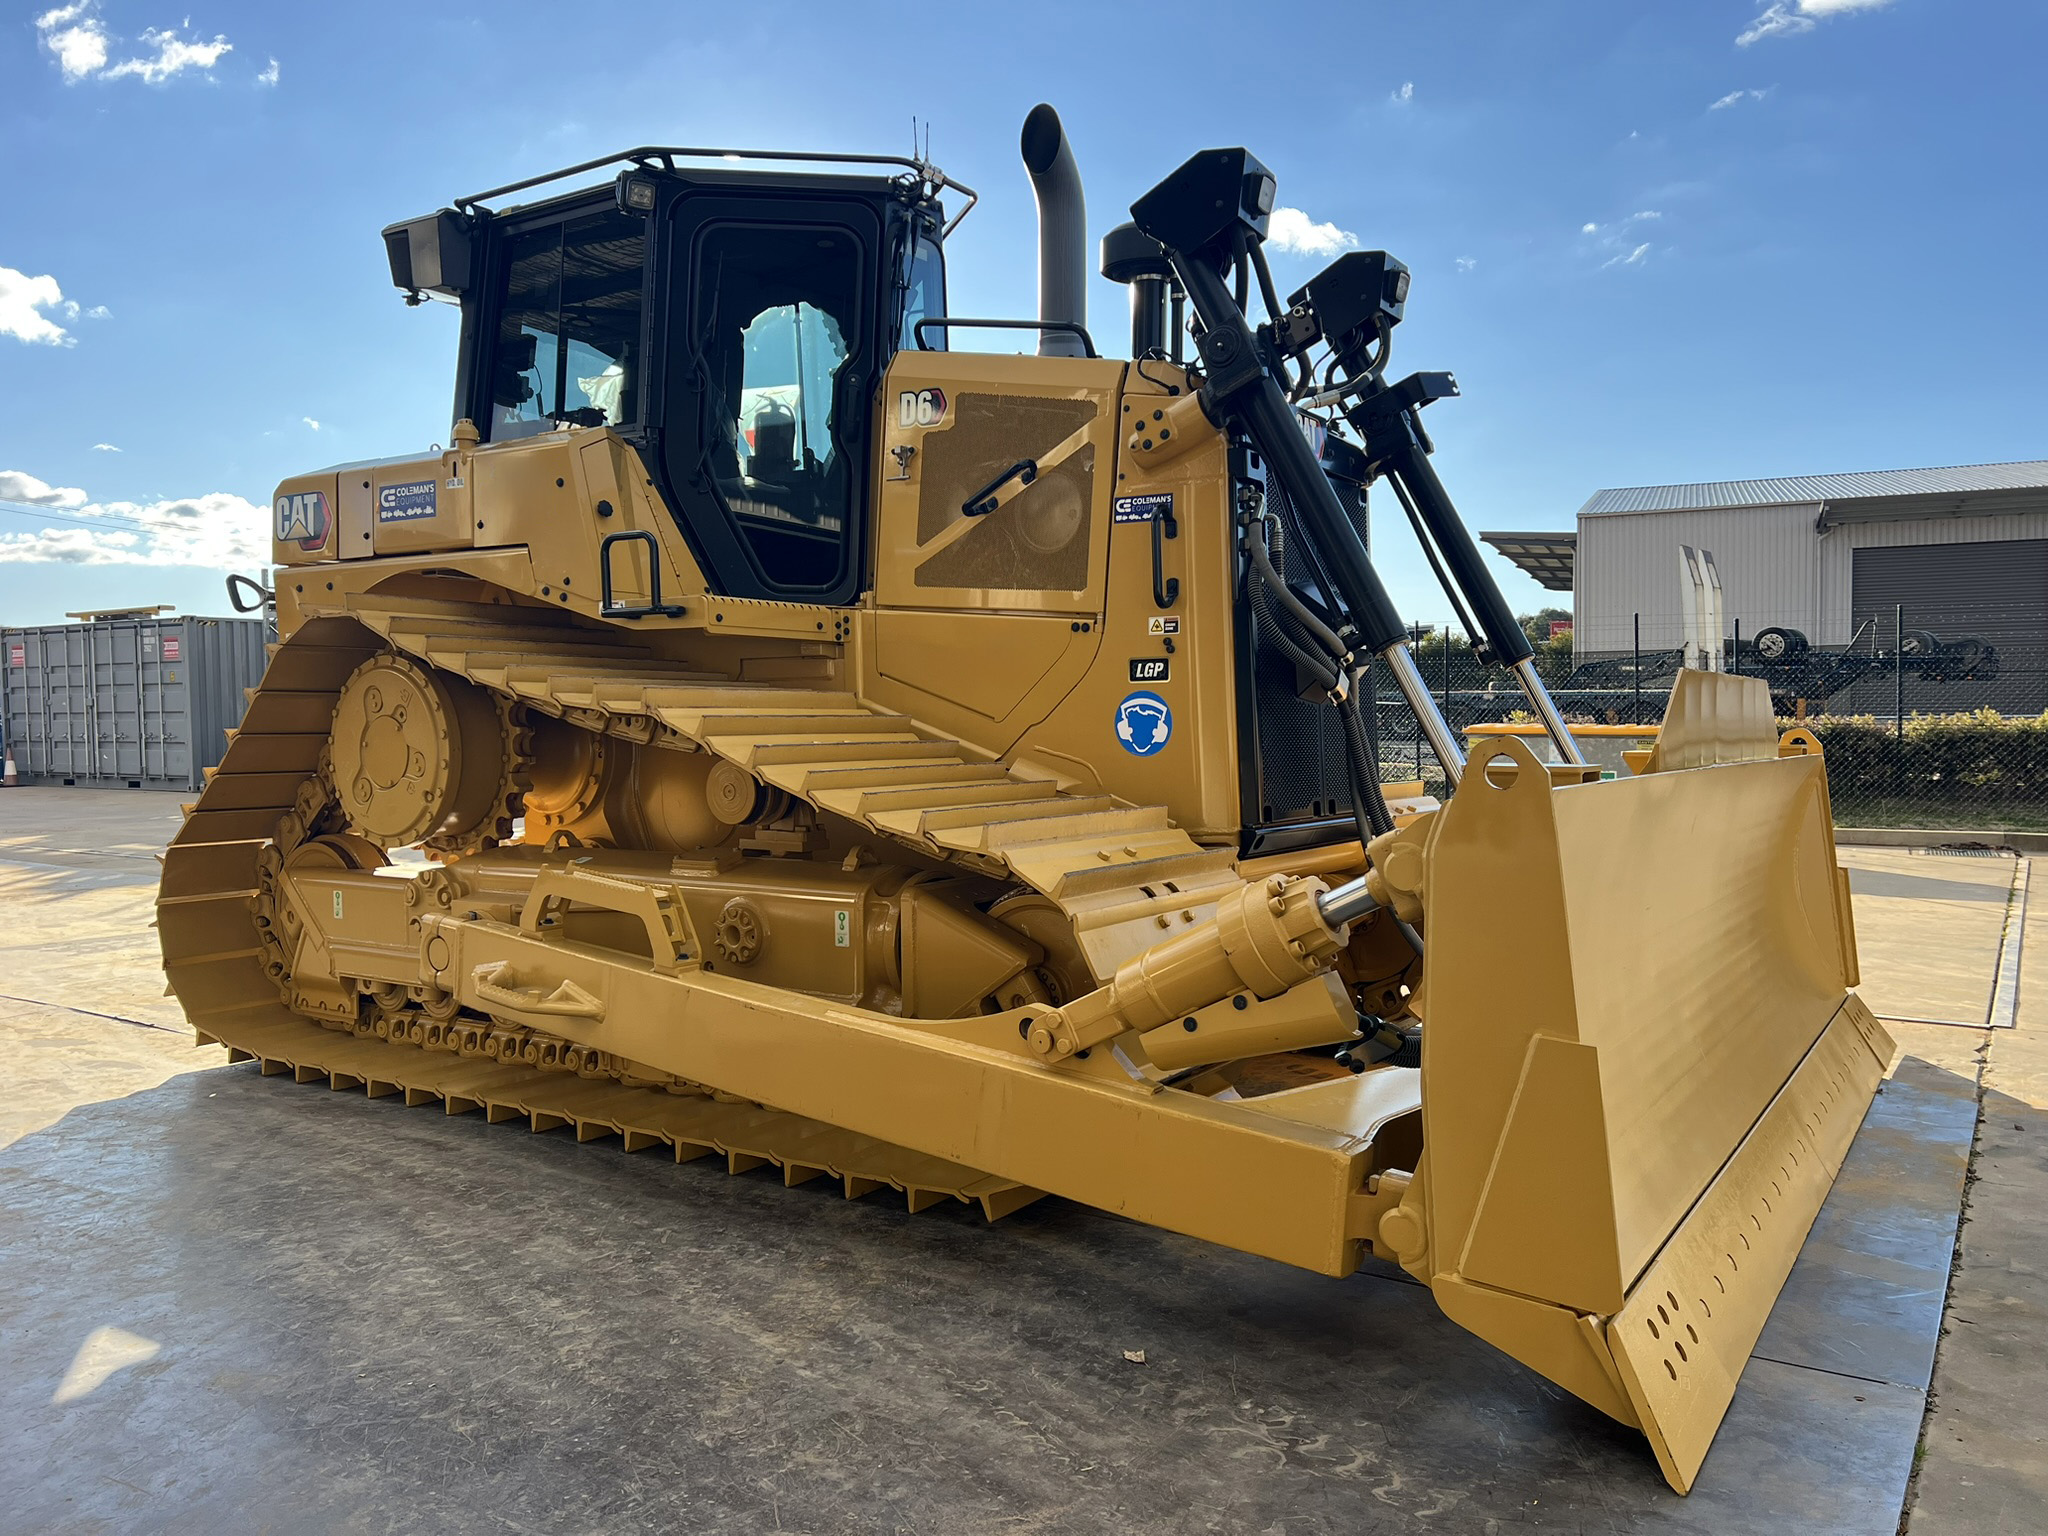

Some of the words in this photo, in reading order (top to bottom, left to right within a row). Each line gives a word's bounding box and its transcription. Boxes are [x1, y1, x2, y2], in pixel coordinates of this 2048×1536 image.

[900, 390, 933, 426] D6
[396, 483, 435, 496] COLEMAN'S
[396, 493, 435, 506] EQUIPMENT
[1132, 495, 1171, 505] COLEMAN'S
[276, 493, 318, 540] CAT
[1135, 662, 1164, 678] LGP
